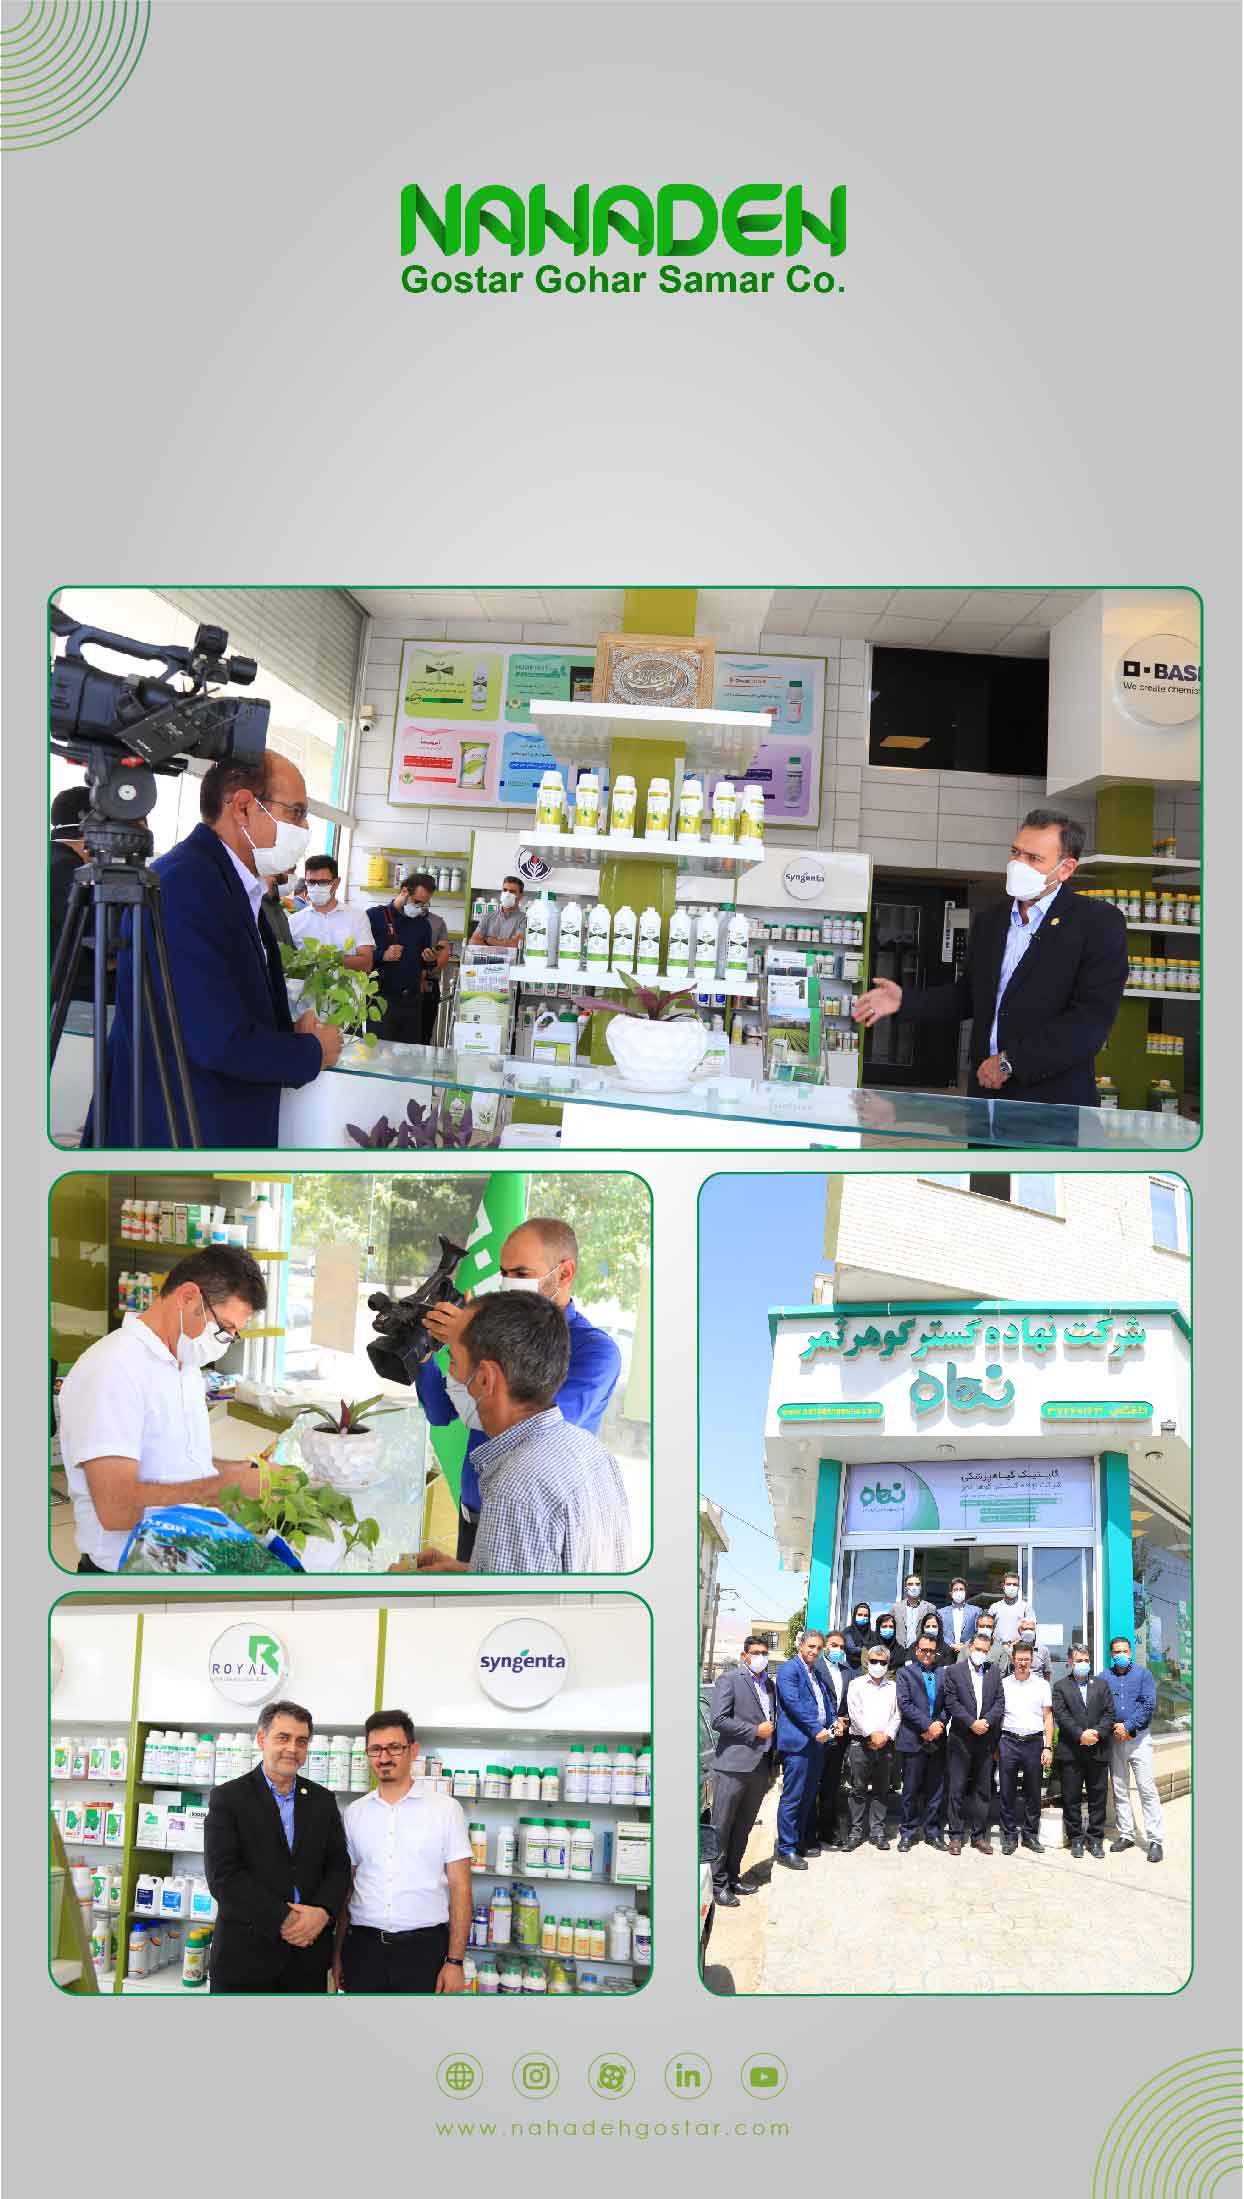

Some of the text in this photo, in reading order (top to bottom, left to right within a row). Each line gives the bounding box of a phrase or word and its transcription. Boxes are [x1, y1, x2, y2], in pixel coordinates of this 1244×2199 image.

[1154, 663, 1201, 682] BAS
[1123, 681, 1137, 691] We
[1139, 684, 1167, 693] create
[785, 873, 825, 884] syngenta
[799, 1314, 1147, 1359] شرکت نهاده گستر گوهر ثمر
[212, 1663, 269, 1676] ROYAL
[480, 1652, 566, 1674] syngenta
